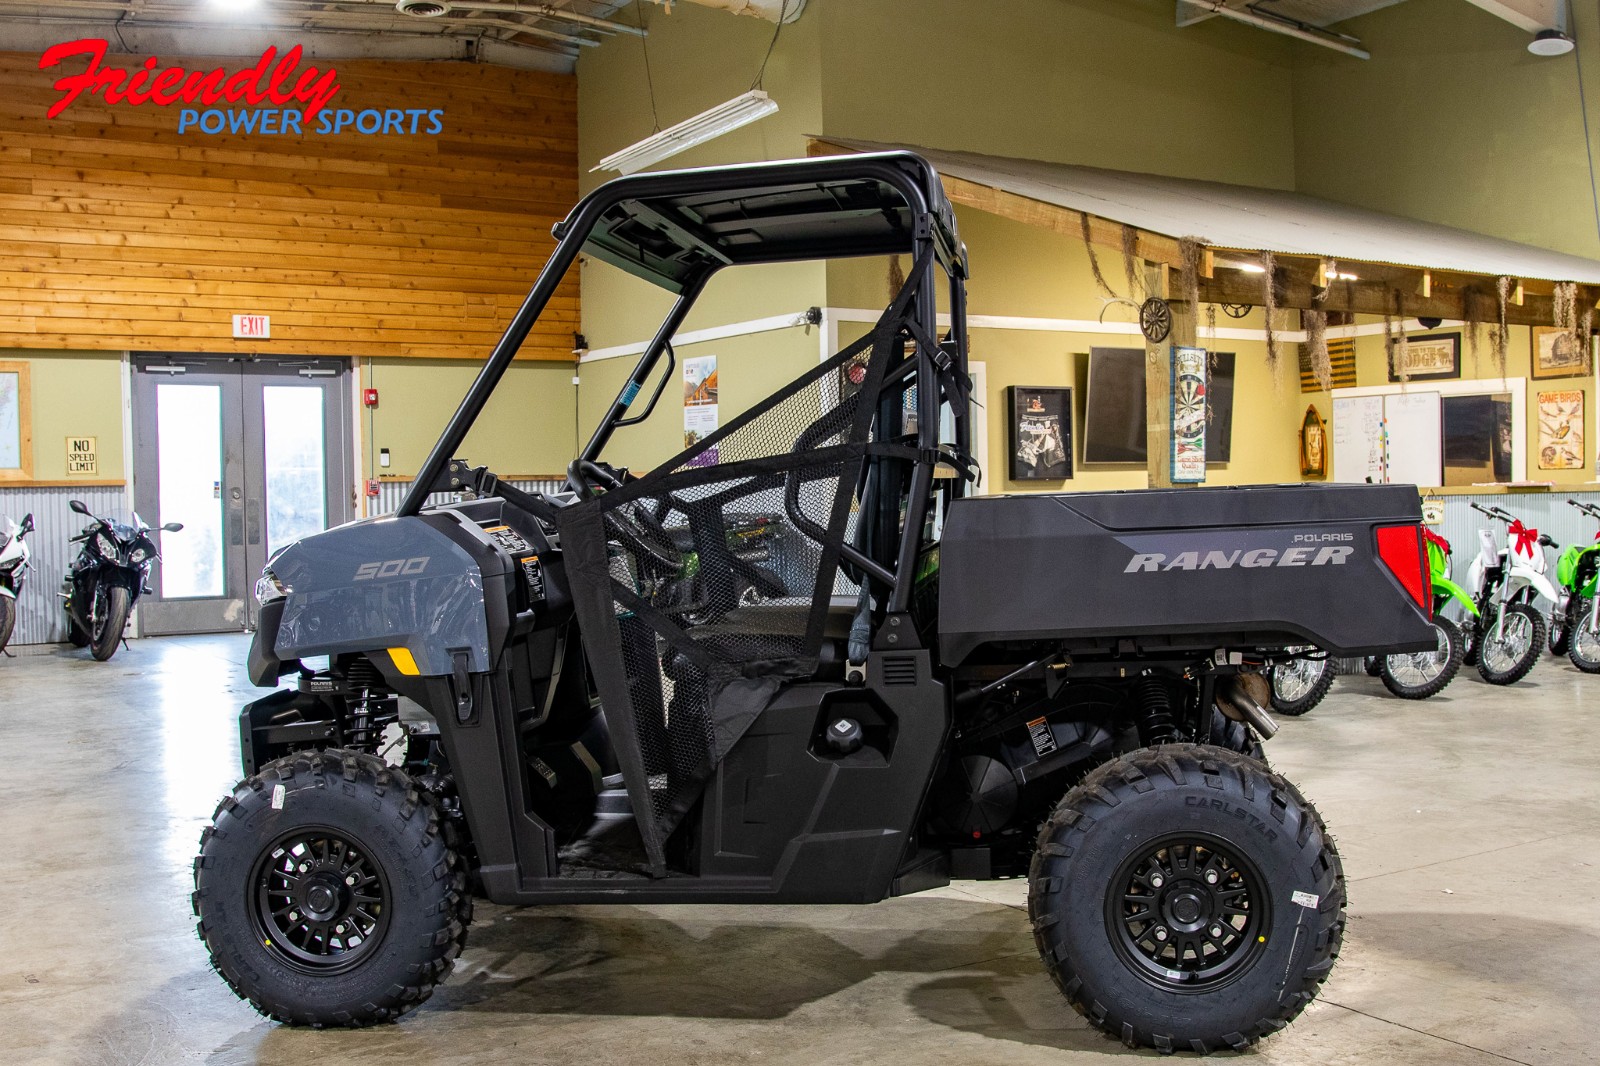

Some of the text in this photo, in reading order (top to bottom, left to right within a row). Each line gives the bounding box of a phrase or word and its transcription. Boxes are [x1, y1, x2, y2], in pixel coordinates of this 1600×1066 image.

[241, 316, 265, 335] EXIT
[1539, 391, 1582, 404] GAME BIRDS
[73, 439, 89, 452] NO
[69, 453, 95, 462] SPEED
[69, 462, 94, 472] LIMIT
[1293, 532, 1354, 543] POLARIS
[1123, 545, 1355, 574] RANGER
[353, 557, 430, 581] 500
[1184, 795, 1278, 843] CARLSTAR
